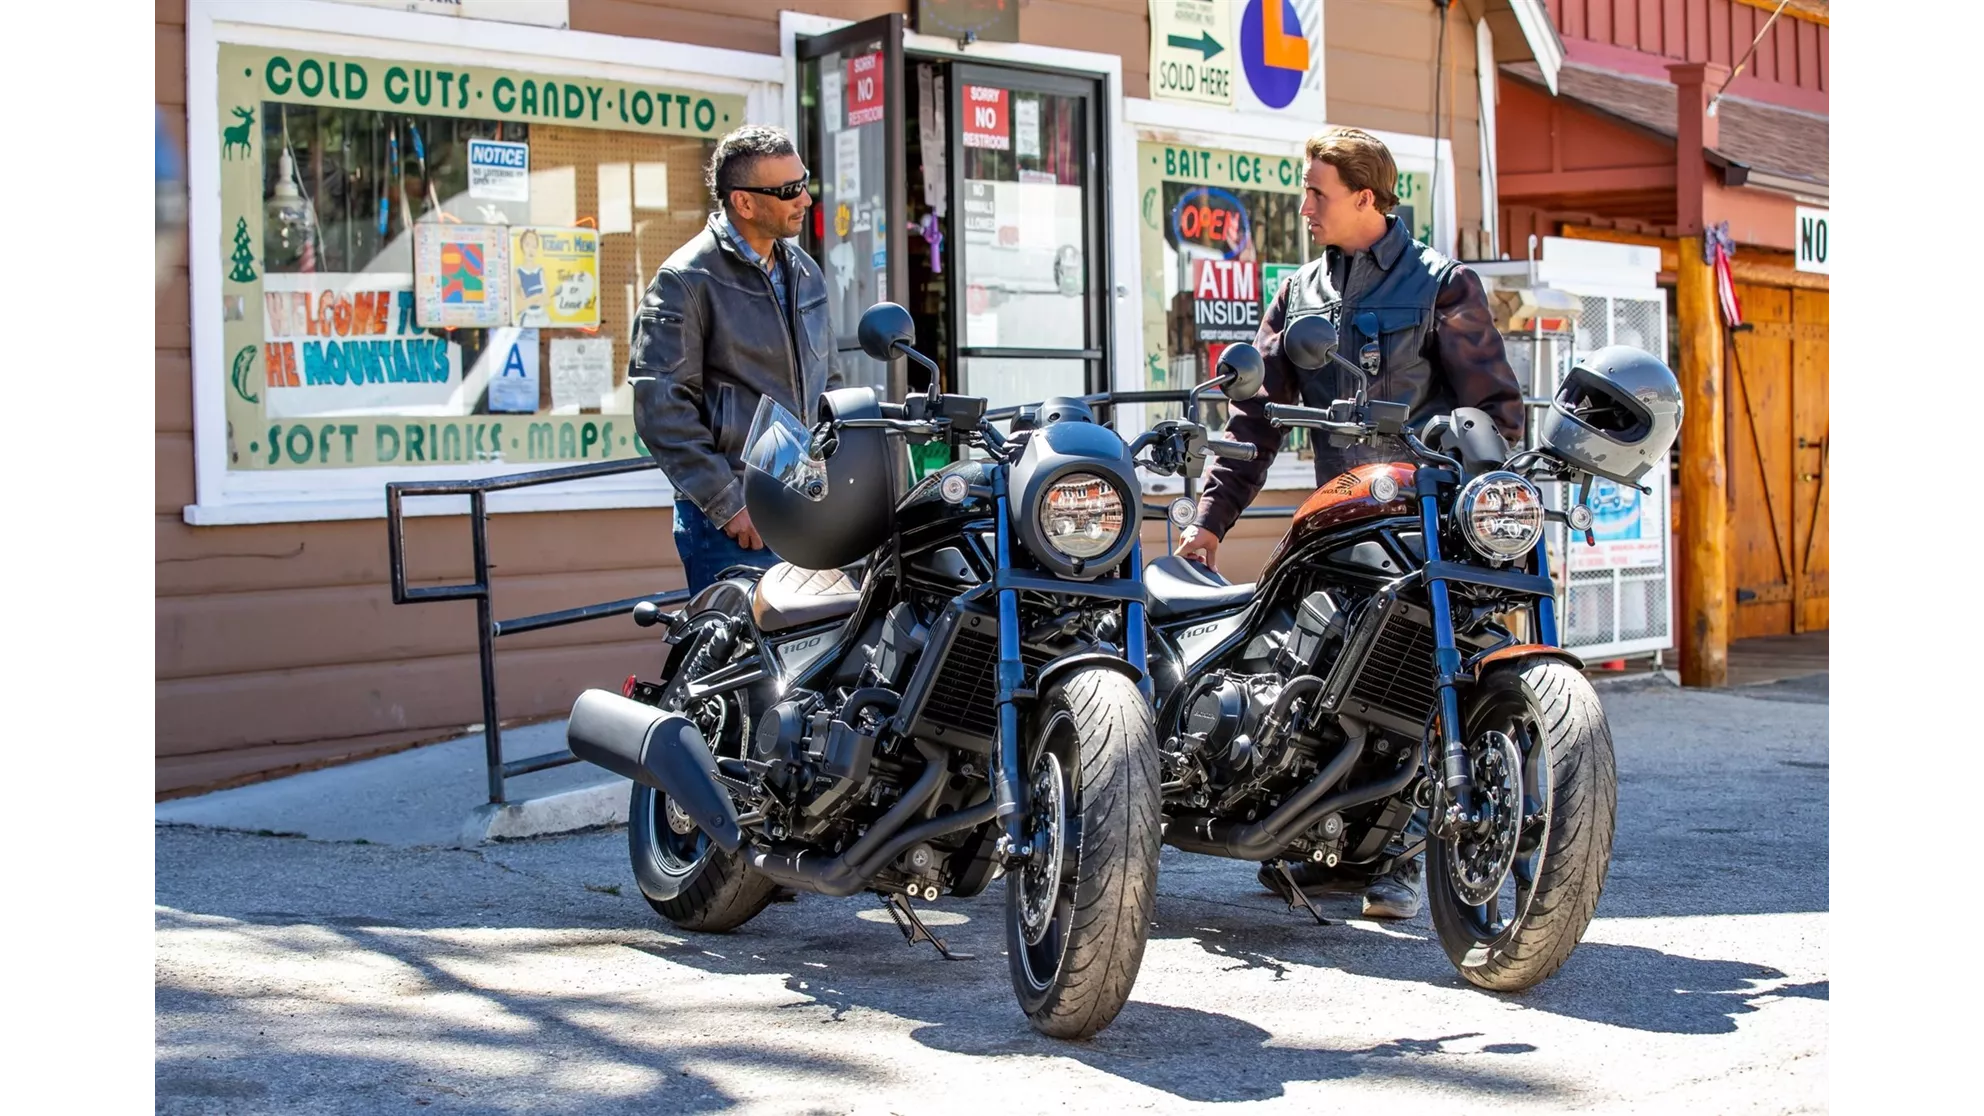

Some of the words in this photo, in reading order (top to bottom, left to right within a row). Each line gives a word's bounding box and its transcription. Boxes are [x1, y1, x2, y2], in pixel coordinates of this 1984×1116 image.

[854, 54, 876, 73] SORRY
[266, 56, 368, 100] COLD
[384, 66, 470, 109] CUTS
[493, 77, 603, 121] CANDY
[619, 88, 716, 132] LOTTO
[857, 77, 873, 102] NO
[1160, 61, 1195, 91] SOLD
[1200, 66, 1229, 97] HERE
[970, 86, 999, 103] SORRY
[975, 106, 996, 129] NO
[473, 145, 524, 166] NOTICE
[963, 132, 1009, 150] RESTROOM
[1165, 148, 1210, 179] BAIT
[1229, 154, 1261, 184] ICE
[1181, 204, 1240, 242] OPEN
[1802, 217, 1827, 263] NO
[1199, 260, 1254, 300] ATM
[265, 290, 390, 336] WELCOME
[1195, 300, 1259, 325] INSIDE
[303, 337, 450, 386] MOUNTAINS
[503, 342, 526, 378] A
[268, 424, 358, 465] SOFT
[376, 423, 502, 462] DRINKS
[528, 422, 613, 459] MAPS
[1321, 488, 1353, 496] HONDA
[783, 637, 821, 654] 1100
[1180, 624, 1218, 640] 1100
